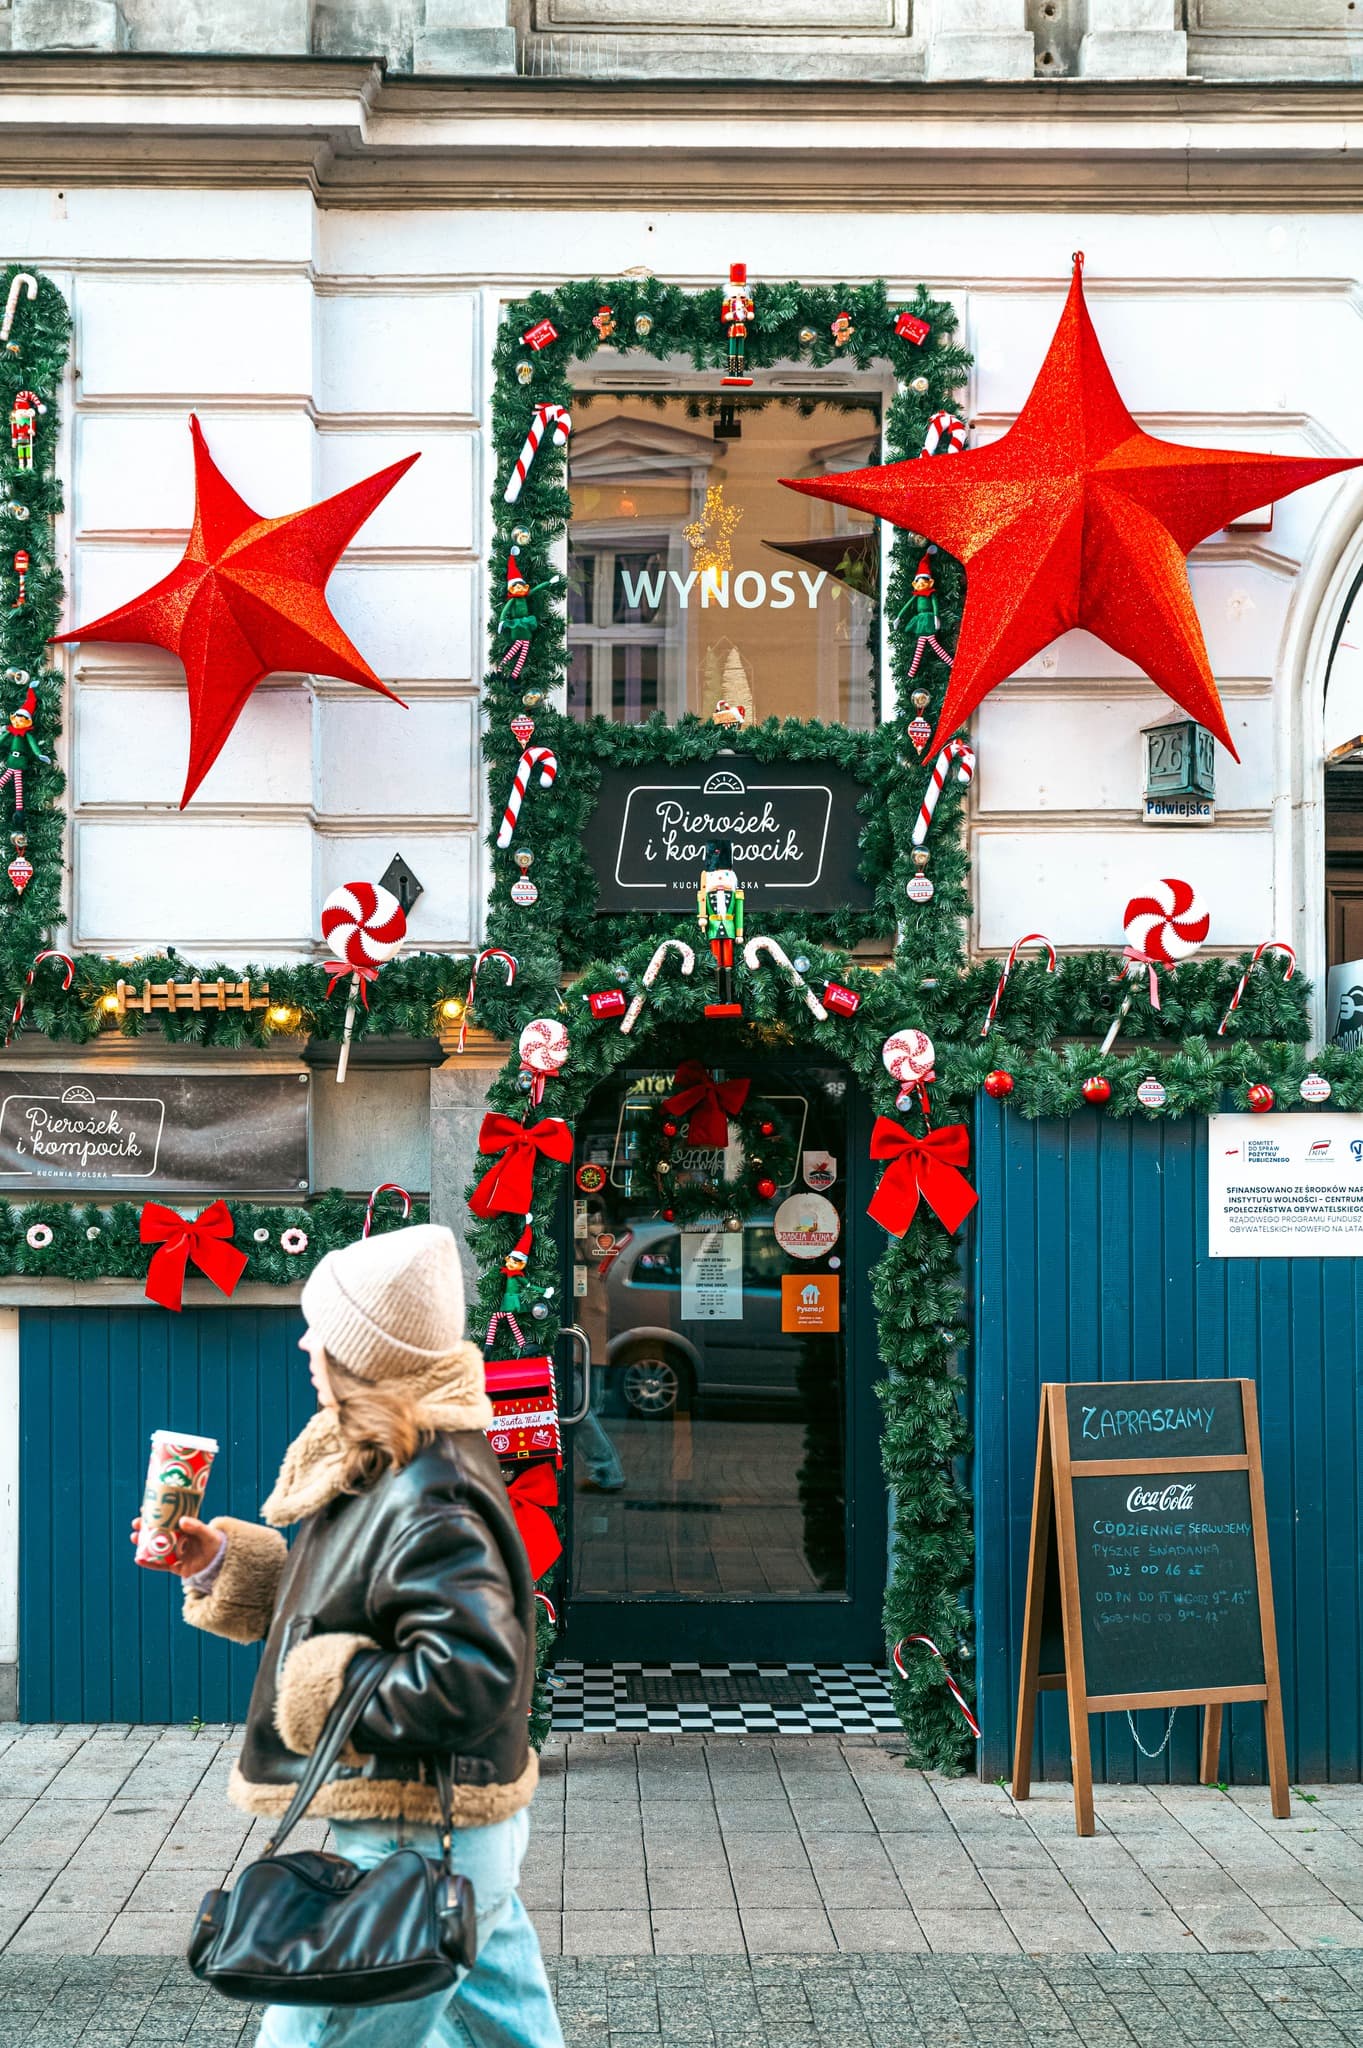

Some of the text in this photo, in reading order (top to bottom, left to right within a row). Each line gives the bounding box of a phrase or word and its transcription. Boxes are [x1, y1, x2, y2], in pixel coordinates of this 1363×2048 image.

[621, 570, 828, 609] WYNOSY
[1146, 800, 1210, 817] Półwiejska
[656, 801, 780, 834] Pierożek
[644, 839, 657, 861] i
[25, 1107, 123, 1135] Pierożek
[15, 1130, 142, 1167] i kompocik
[1305, 1185, 1347, 1194] ŚRODKÓW
[1274, 1195, 1317, 1203] WOLNOŚCI
[1223, 1205, 1292, 1213] SPOŁECZEŃSTWA
[1229, 1216, 1280, 1224] RZĄDOWEGO
[499, 1416, 523, 1427] Santa
[1082, 1406, 1215, 1440] ZAPRASZAMY
[1092, 1544, 1140, 1558] PYSZNE
[1141, 1565, 1159, 1575] OD
[1165, 1563, 1181, 1576] 16
[1095, 1591, 1113, 1602] OD
[1138, 1591, 1154, 1602] DO
